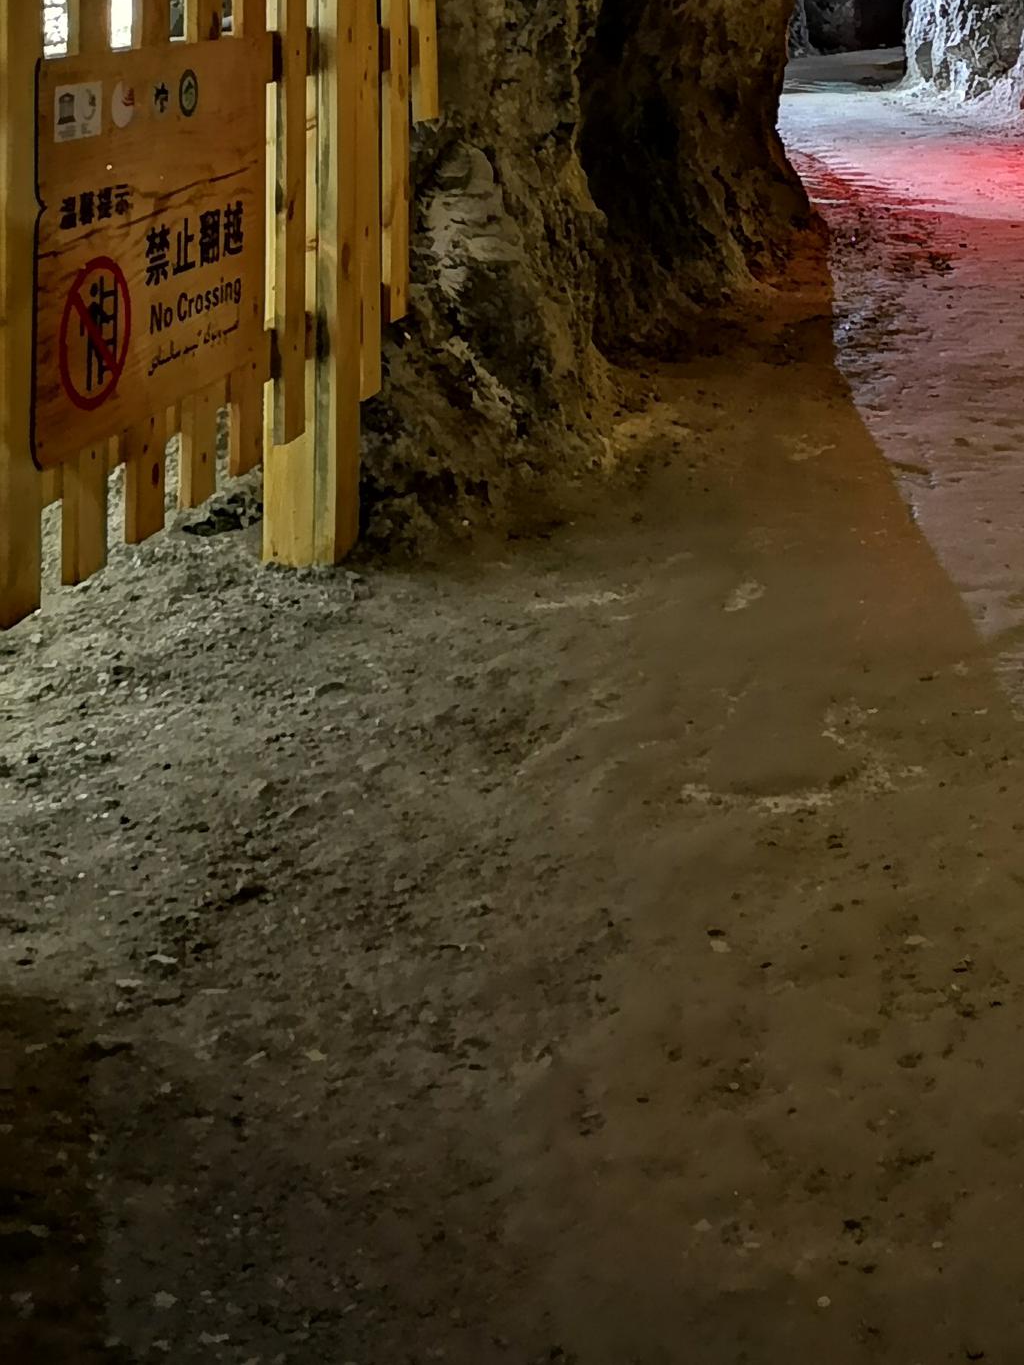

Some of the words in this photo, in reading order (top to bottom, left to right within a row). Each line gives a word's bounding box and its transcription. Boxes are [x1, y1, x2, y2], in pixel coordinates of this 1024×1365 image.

[145, 200, 244, 287] 禁止翻越
[149, 301, 174, 335] No
[176, 276, 242, 323] Crossing
